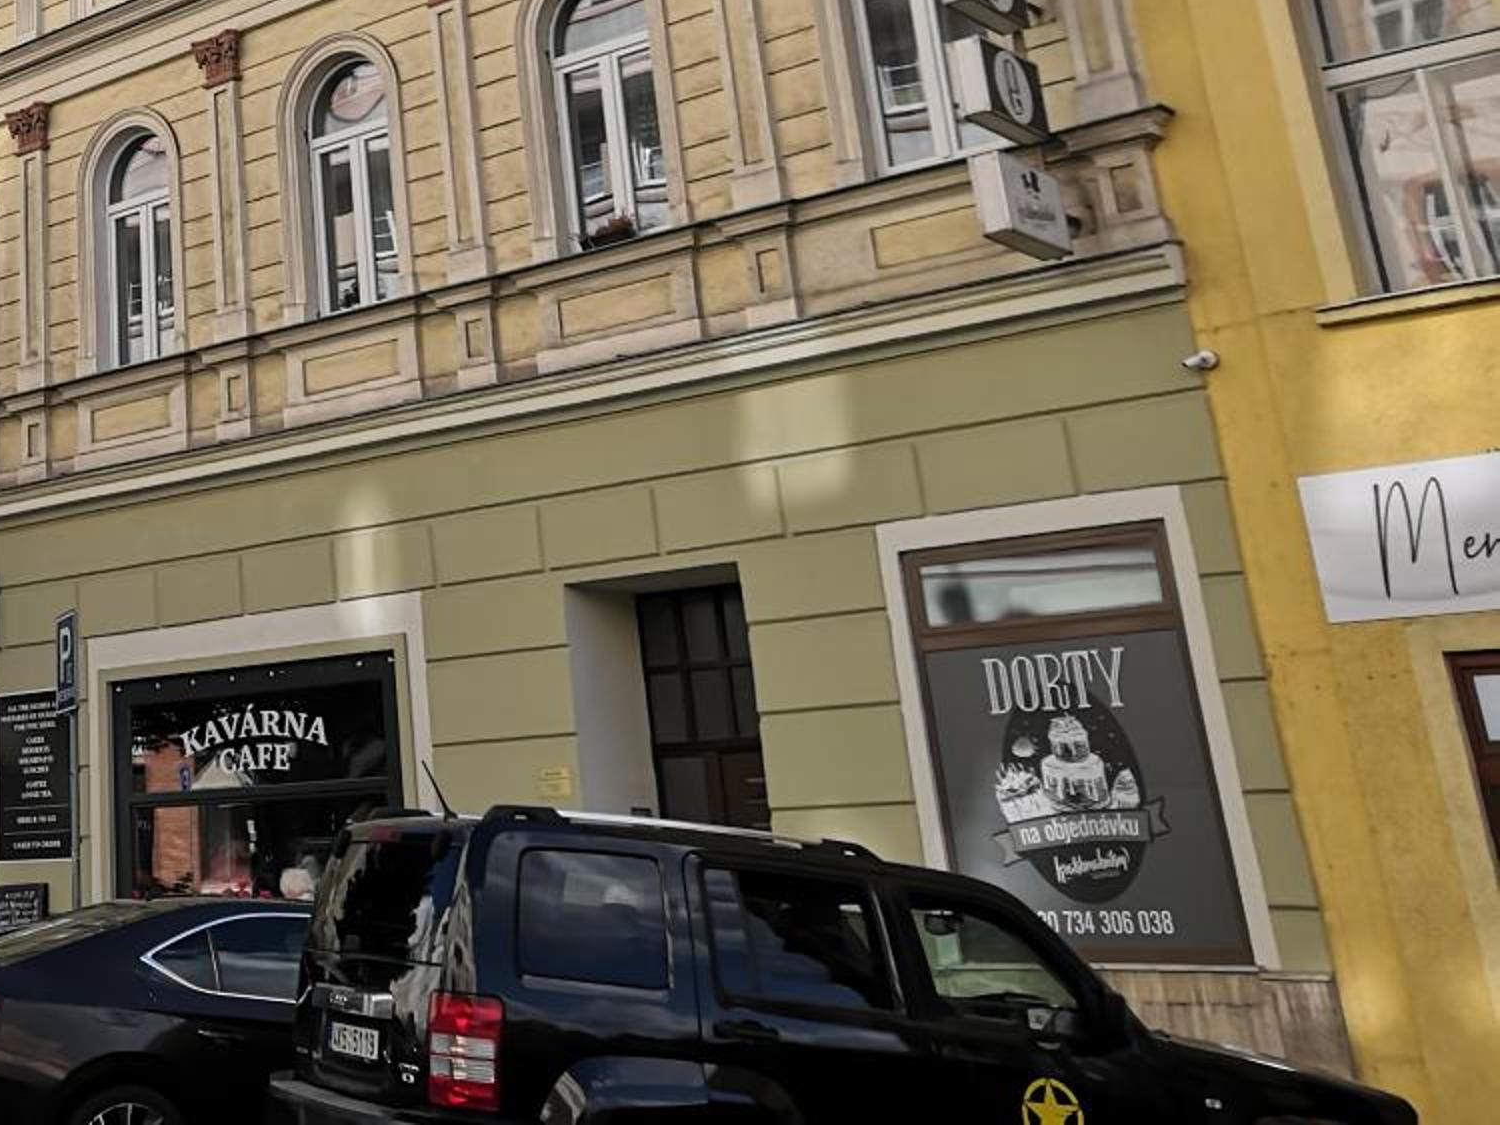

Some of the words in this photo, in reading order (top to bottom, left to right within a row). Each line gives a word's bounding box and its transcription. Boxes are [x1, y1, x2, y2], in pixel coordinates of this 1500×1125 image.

[59, 626, 71, 684] P
[980, 646, 1125, 714] DORTY
[180, 702, 329, 758] KAVÁRNA
[219, 743, 292, 775] CAFE
[1020, 826, 1042, 846] na
[1044, 813, 1140, 844] objednávku
[1062, 910, 1095, 934] 734
[1099, 910, 1134, 934] 306
[1137, 910, 1175, 934] 038
